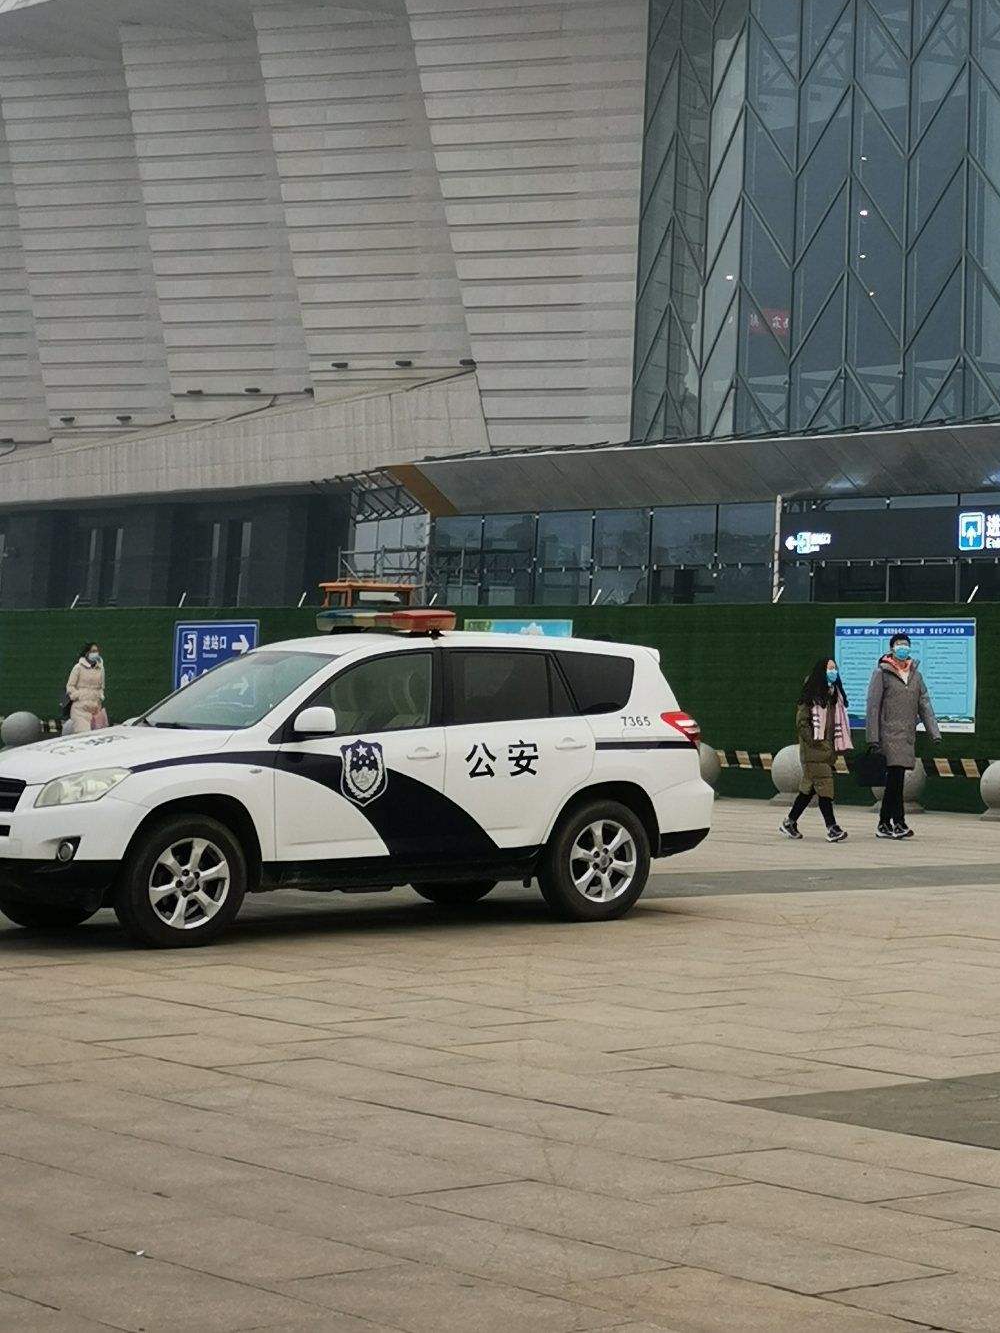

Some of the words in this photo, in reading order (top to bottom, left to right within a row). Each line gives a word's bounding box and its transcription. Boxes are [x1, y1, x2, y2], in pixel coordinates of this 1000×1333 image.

[202, 634, 227, 651] 进站口
[621, 716, 651, 727] 7365
[465, 739, 539, 778] 公安
